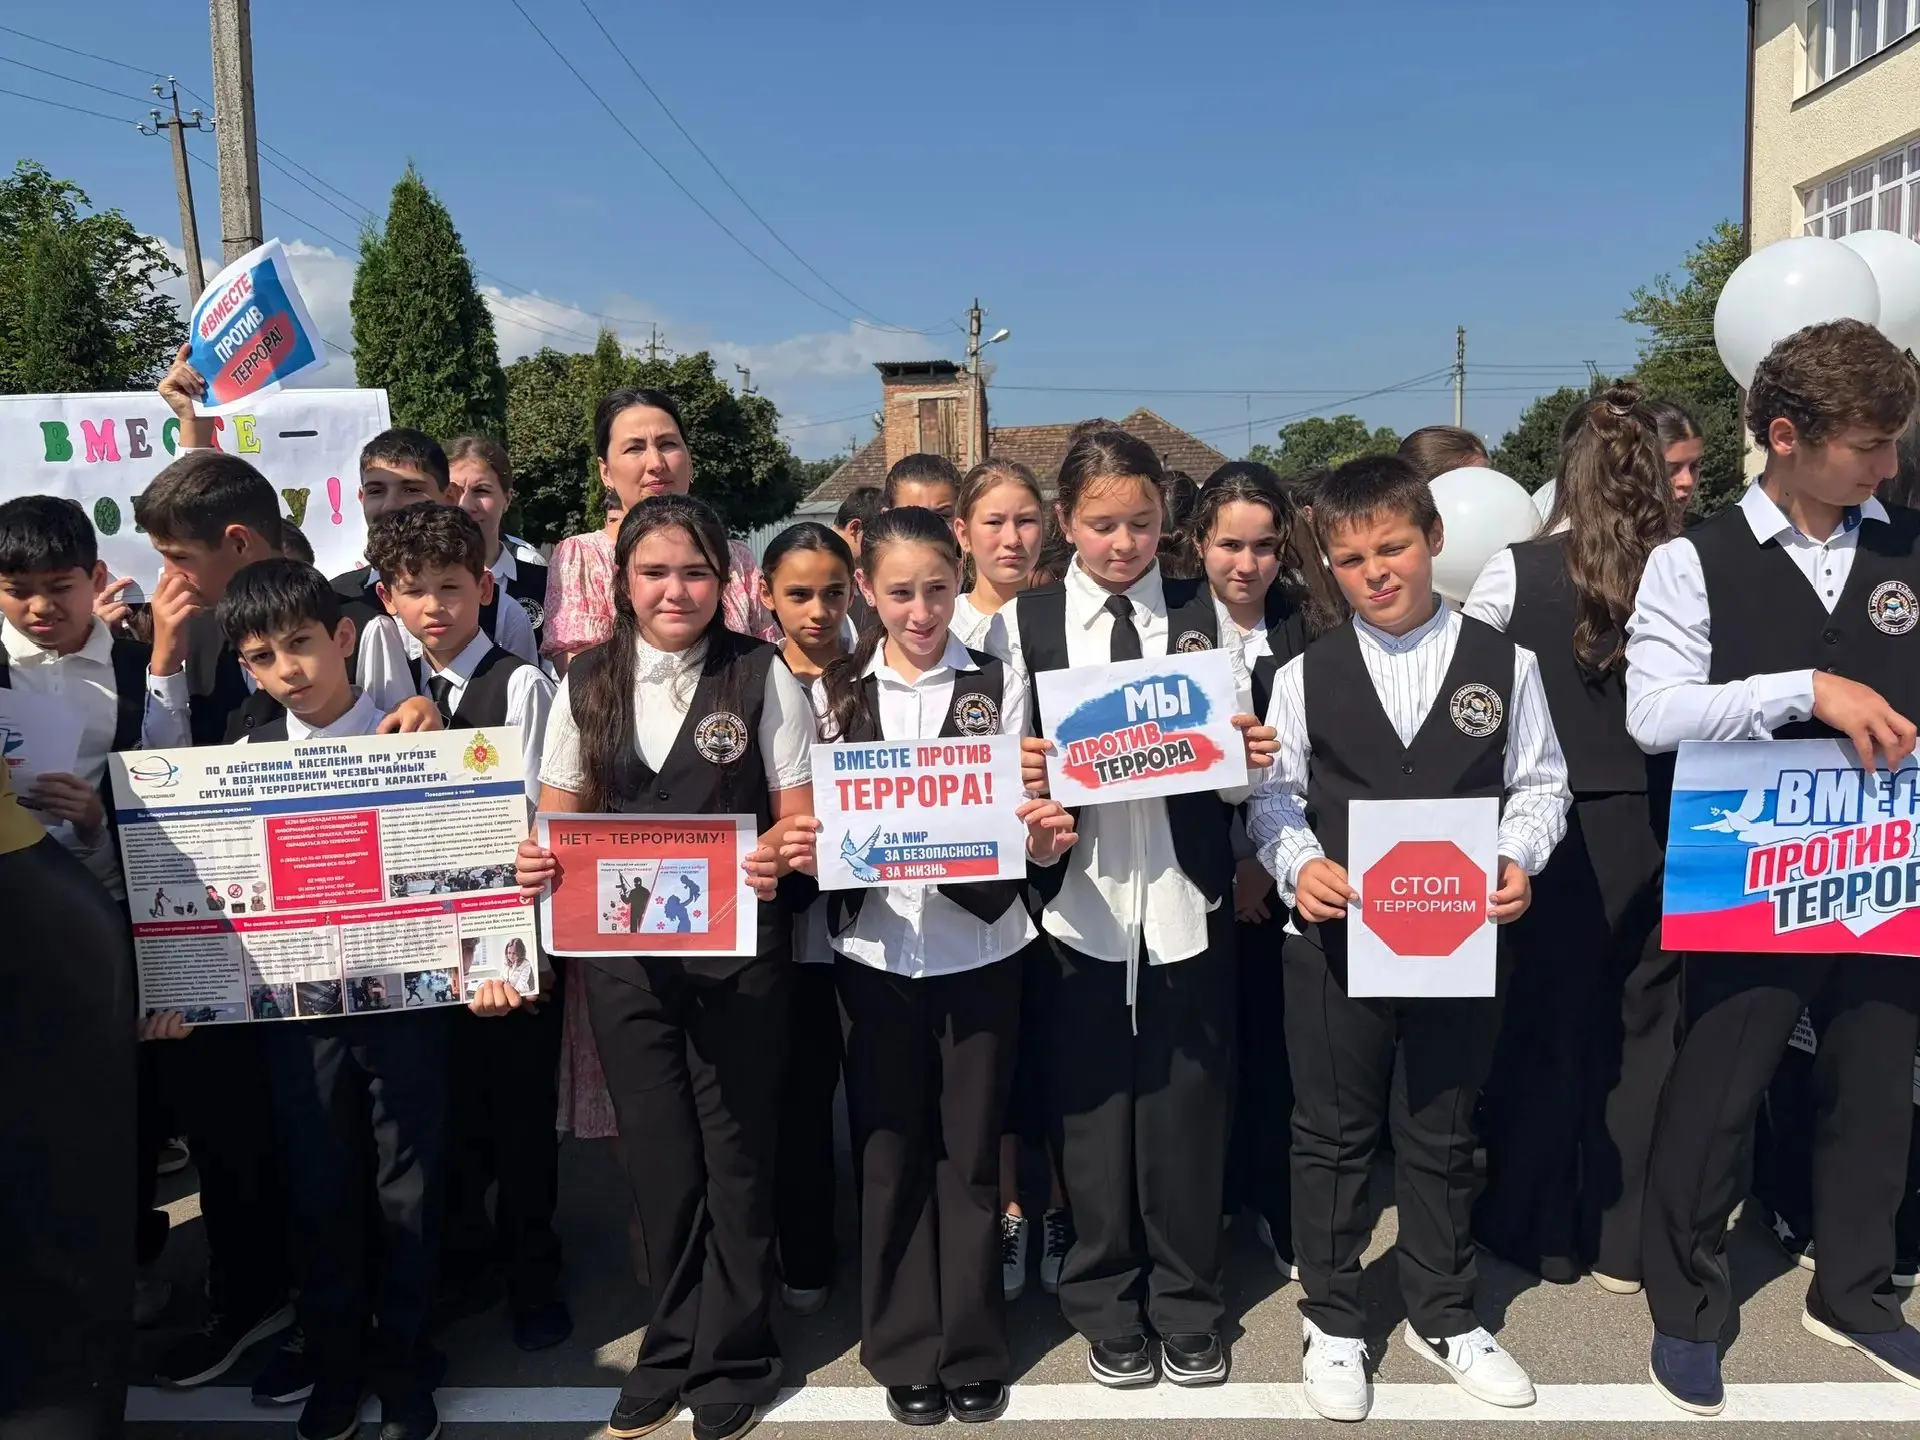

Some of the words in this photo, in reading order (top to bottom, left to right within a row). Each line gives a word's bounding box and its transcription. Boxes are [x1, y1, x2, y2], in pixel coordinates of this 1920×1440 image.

[200, 272, 252, 339] #ВМЕСТЕ
[214, 305, 264, 364] ПРОТИВ
[230, 325, 284, 387] ТЕРРОРА!
[1124, 680, 1191, 722] МЫ
[294, 745, 347, 756] ПАМЯТКА
[833, 748, 911, 771] ВМЕСТЕ
[917, 744, 992, 767] ПРОТИВ
[1068, 723, 1162, 766] ПРОТИВ
[205, 766, 219, 774] ПО
[225, 758, 292, 773] ДЕЙСТВИЯМ
[298, 755, 362, 768] НАСЕЛЕНИЯ
[368, 753, 390, 762] ПРИ
[396, 749, 436, 760] УГРОЗЕ
[219, 777, 226, 785] И
[232, 770, 326, 785] ВОЗНИКНОВЕНИИ
[332, 761, 424, 777] ЧРЕЗВЫЧАЙНЫХ
[1094, 740, 1195, 783] ТЕРРОРА
[198, 785, 254, 799] СИТУАЦИЙ
[260, 777, 378, 794] ТЕРРОРИСТИЧЕСКОГО
[385, 772, 446, 785] ХАРАКТЕРА
[835, 772, 993, 811] ТЕРРОРА!
[560, 833, 591, 845] НЕТ
[609, 832, 725, 845] ТЕРРОРИЗМУ!
[884, 833, 899, 845] ЗА
[902, 831, 929, 844] МИР
[885, 849, 900, 862] ЗА
[903, 845, 993, 861] БЕЗОПАСНОСТЬ
[1749, 819, 1912, 890] ПРОТИВ
[886, 865, 902, 878] ЗА
[905, 863, 947, 877] ЖИЗНЬ
[1391, 877, 1460, 895] СТОП
[1373, 899, 1476, 913] ТЕРРОРИЗМ
